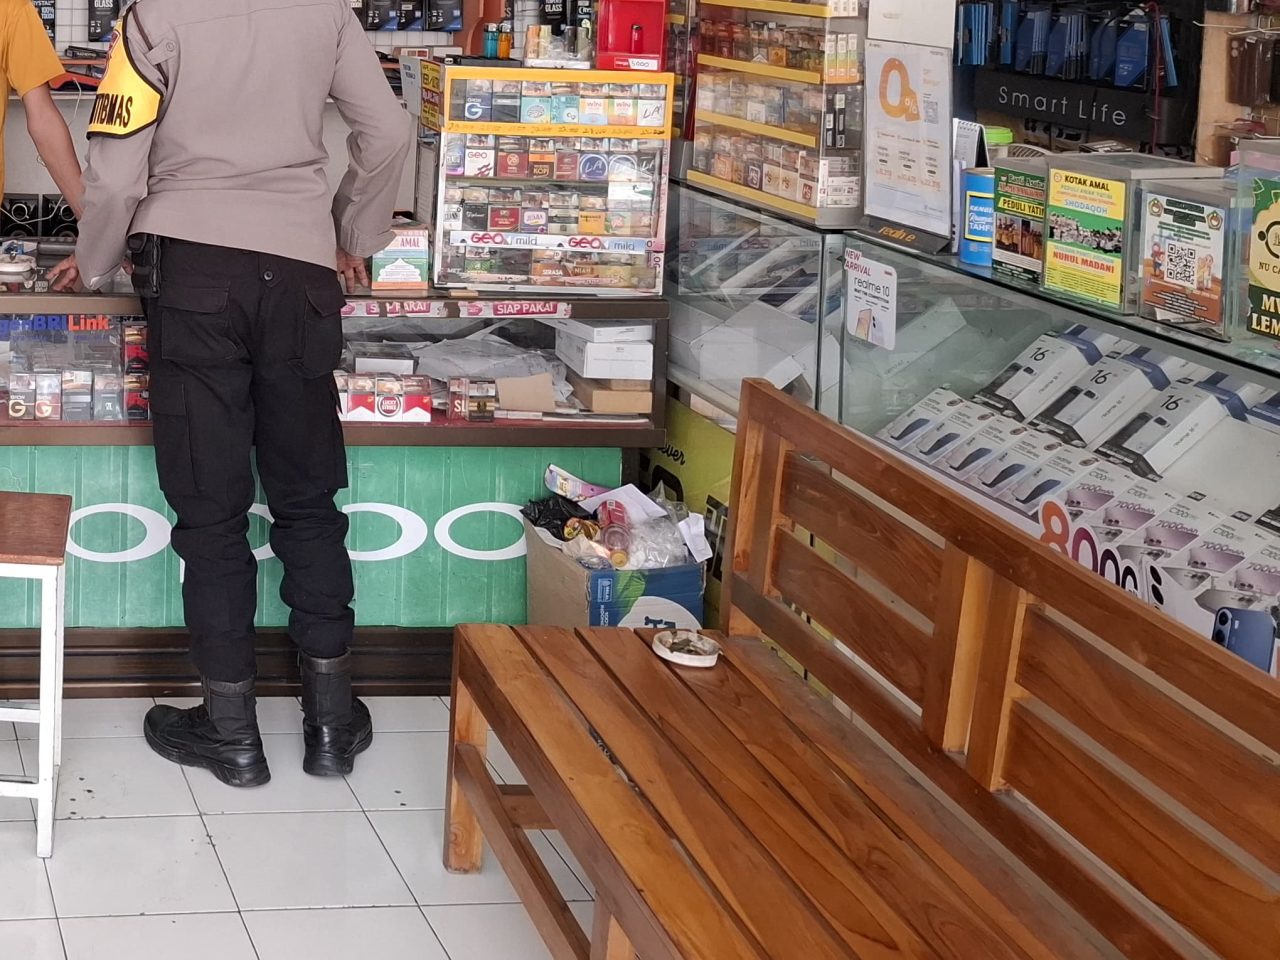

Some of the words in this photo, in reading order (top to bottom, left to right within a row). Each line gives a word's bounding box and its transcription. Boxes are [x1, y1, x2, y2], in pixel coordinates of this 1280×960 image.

[998, 85, 1069, 119] Smart
[1078, 96, 1128, 127] Life
[1065, 175, 1088, 187] KOTAK
[1089, 180, 1111, 192] AMAL
[1003, 198, 1027, 212] PEDULI
[515, 235, 538, 246] mild
[845, 249, 861, 261] NEW
[1053, 251, 1079, 265] NURUL
[1081, 255, 1115, 274] MADANI
[845, 260, 872, 277] ARRIVAL
[1259, 261, 1270, 272] NU
[854, 276, 881, 294] realme
[882, 285, 890, 297] 10
[497, 304, 521, 315] SIAP
[522, 302, 554, 313] PAKAI
[1029, 346, 1049, 362] 16
[1090, 369, 1112, 385] 16
[1160, 393, 1181, 412] 16
